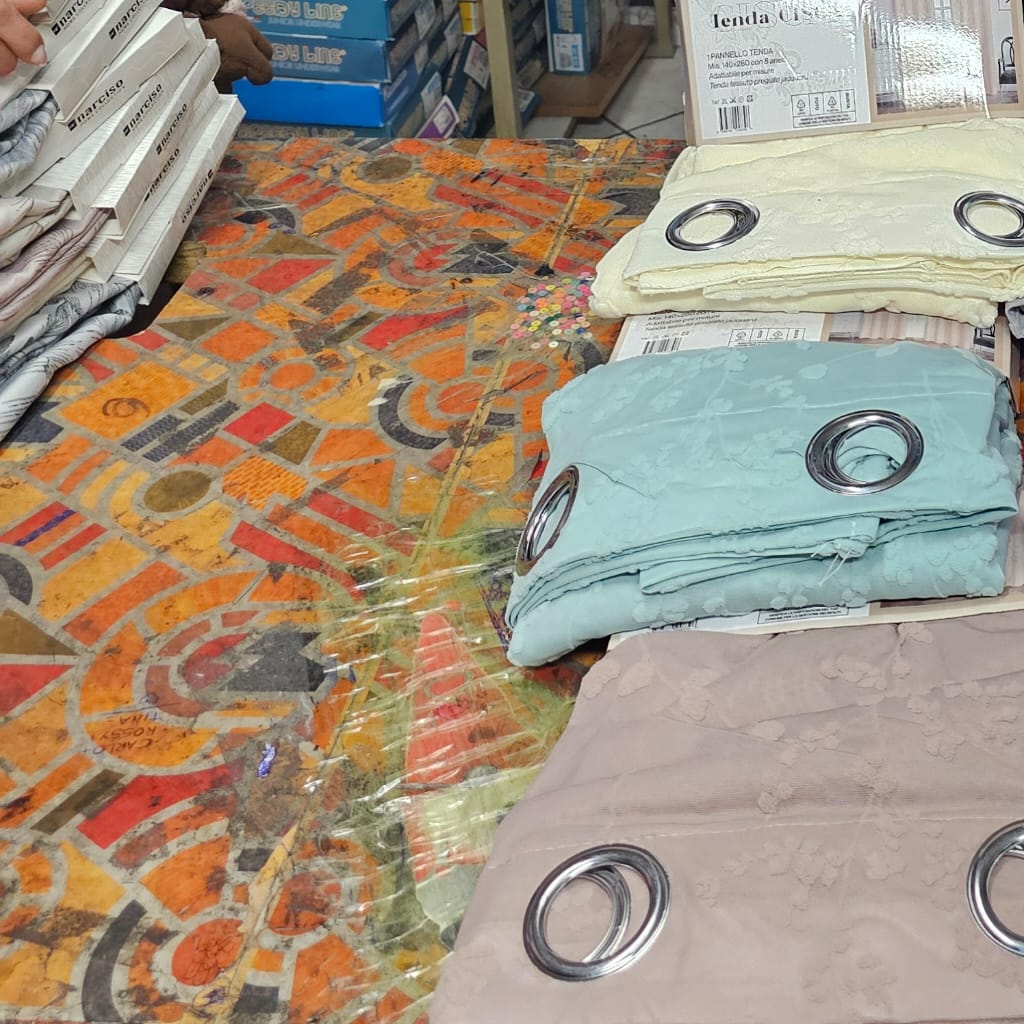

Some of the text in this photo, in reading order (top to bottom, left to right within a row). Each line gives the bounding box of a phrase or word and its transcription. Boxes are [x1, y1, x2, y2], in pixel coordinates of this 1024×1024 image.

[711, 48, 773, 60] PANNELLO TENDA
[76, 78, 124, 124] narciso
[129, 83, 162, 127] narciso
[161, 103, 187, 147] narciso
